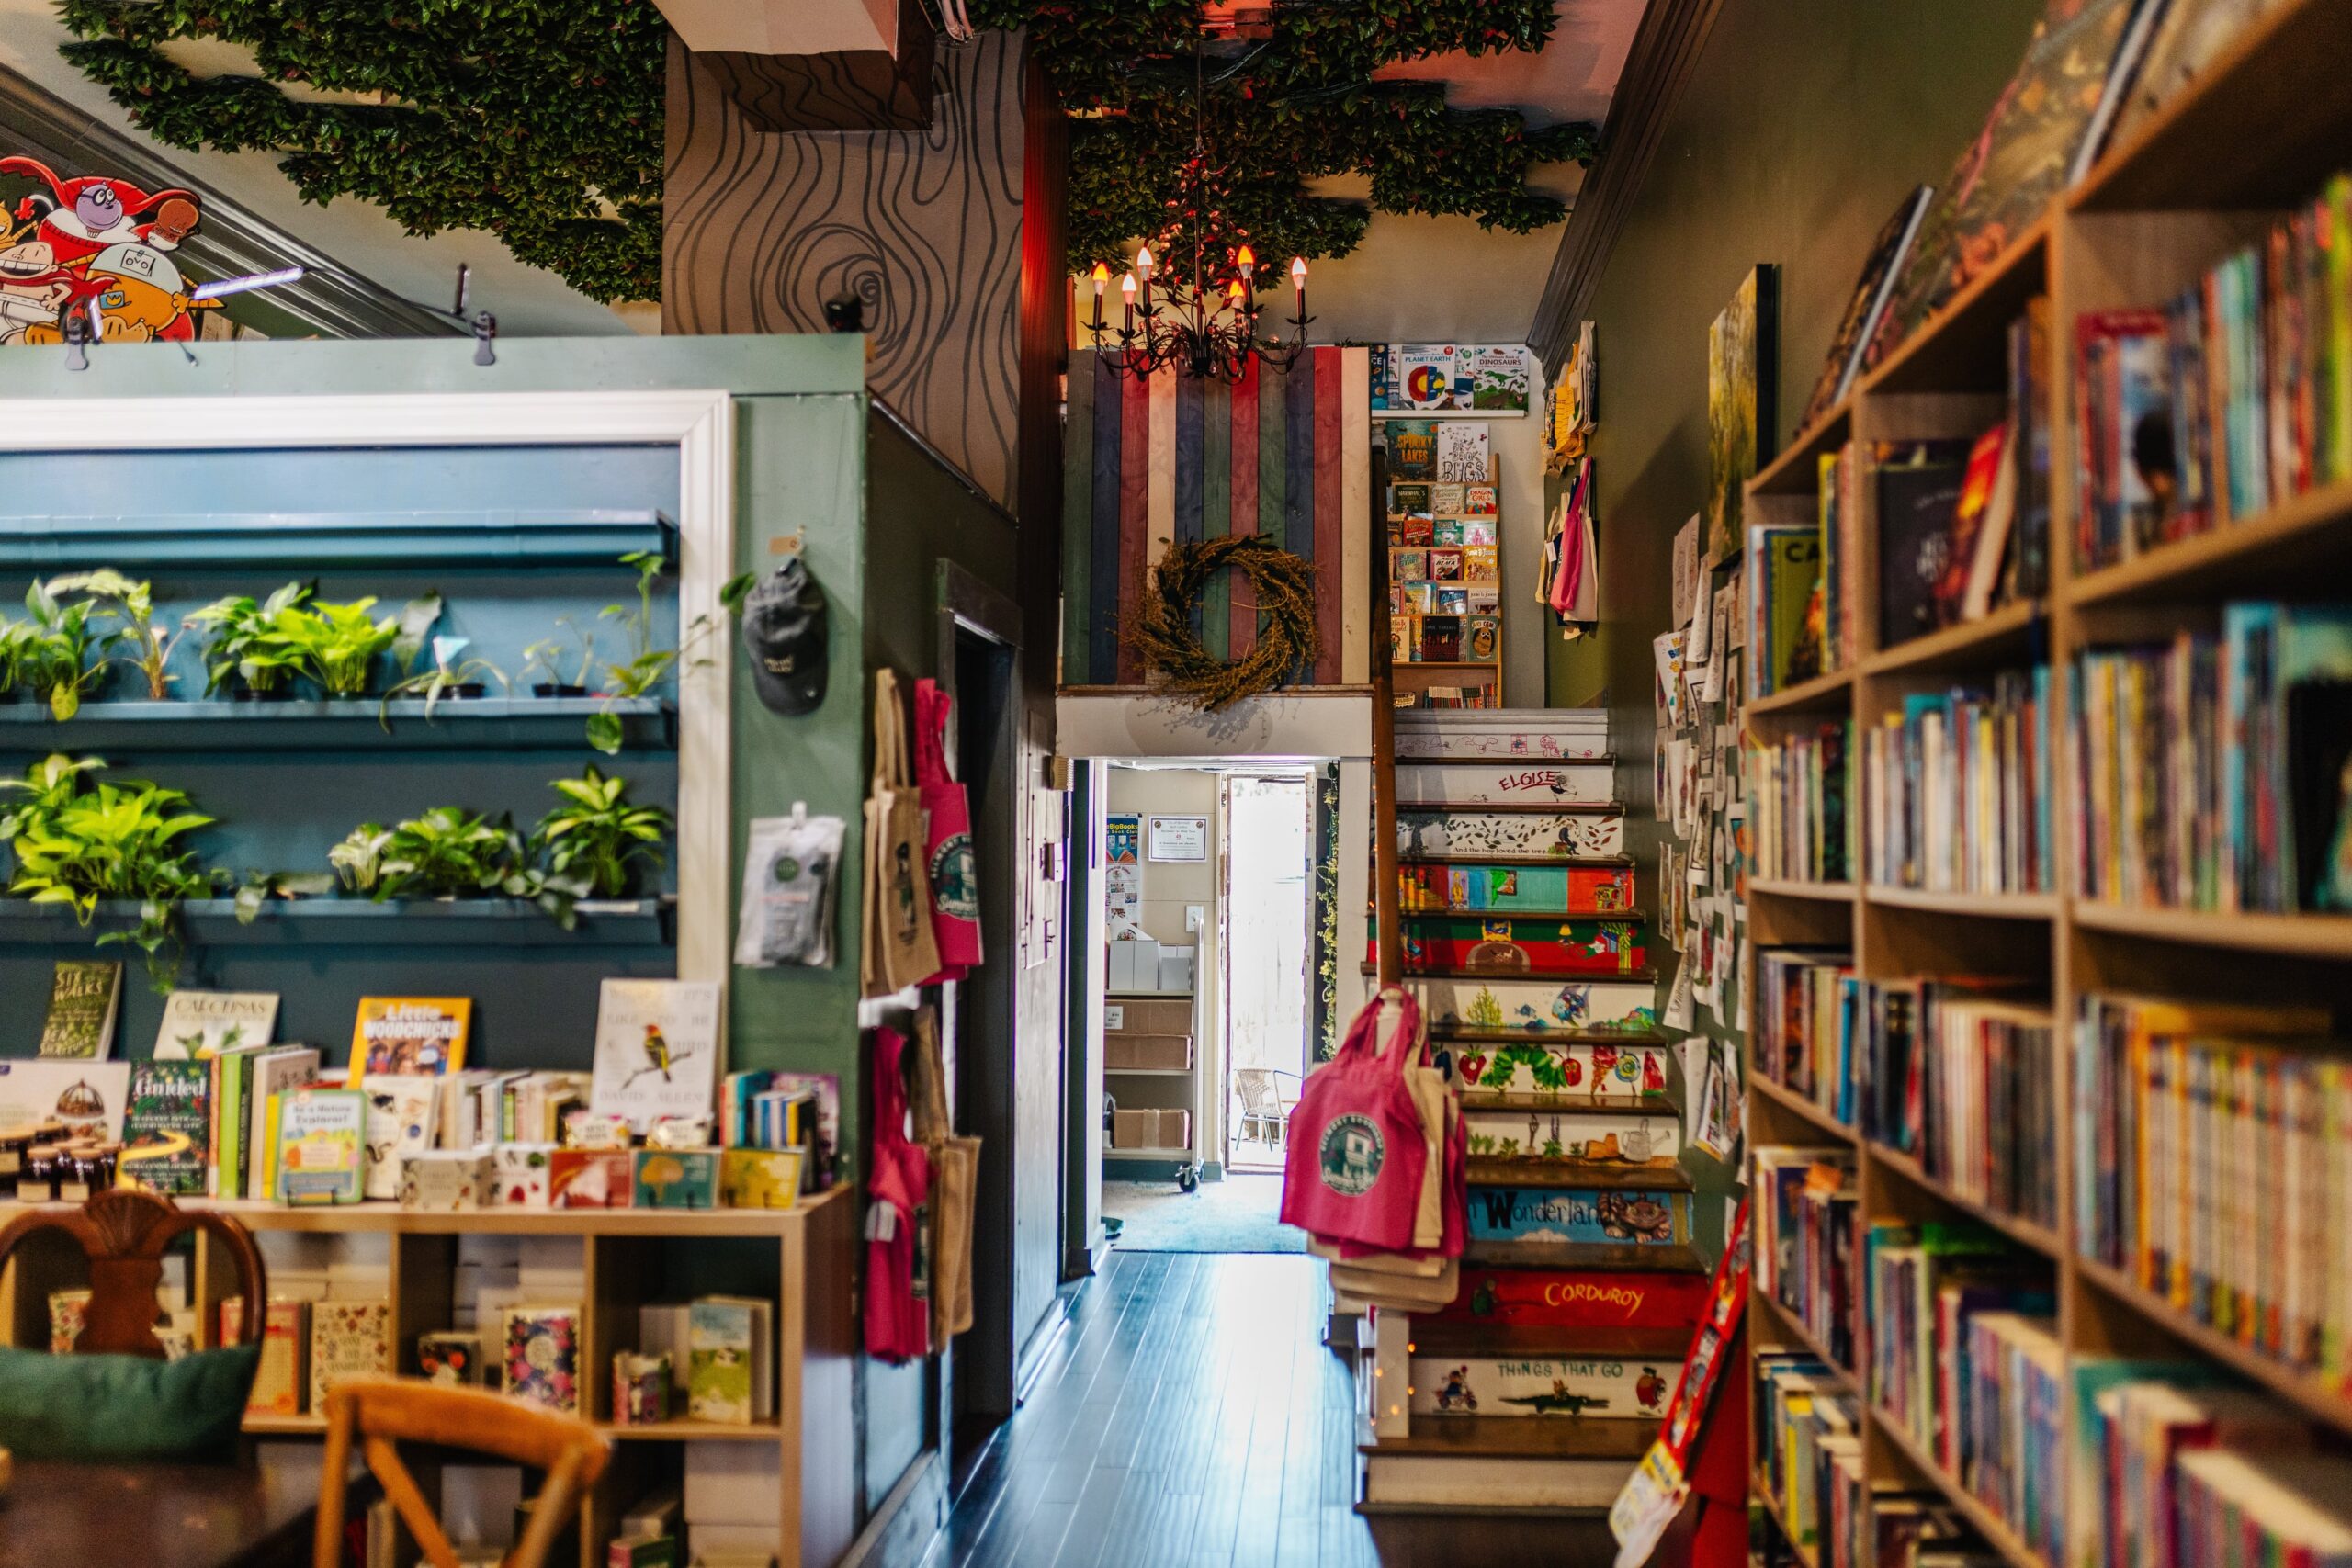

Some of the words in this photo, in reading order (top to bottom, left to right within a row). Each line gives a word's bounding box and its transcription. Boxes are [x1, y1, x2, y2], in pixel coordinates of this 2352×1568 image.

[1397, 434, 1433, 449] SPOOKY
[1401, 449, 1429, 463] LAKES
[1498, 771, 1561, 792] ELOISE
[363, 1021, 462, 1039] WOODCHUCKS
[136, 1077, 207, 1096] Guided
[1544, 1282, 1645, 1319] CORDUROY
[1558, 1360, 1597, 1377] THAT
[1601, 1362, 1624, 1378] GO
